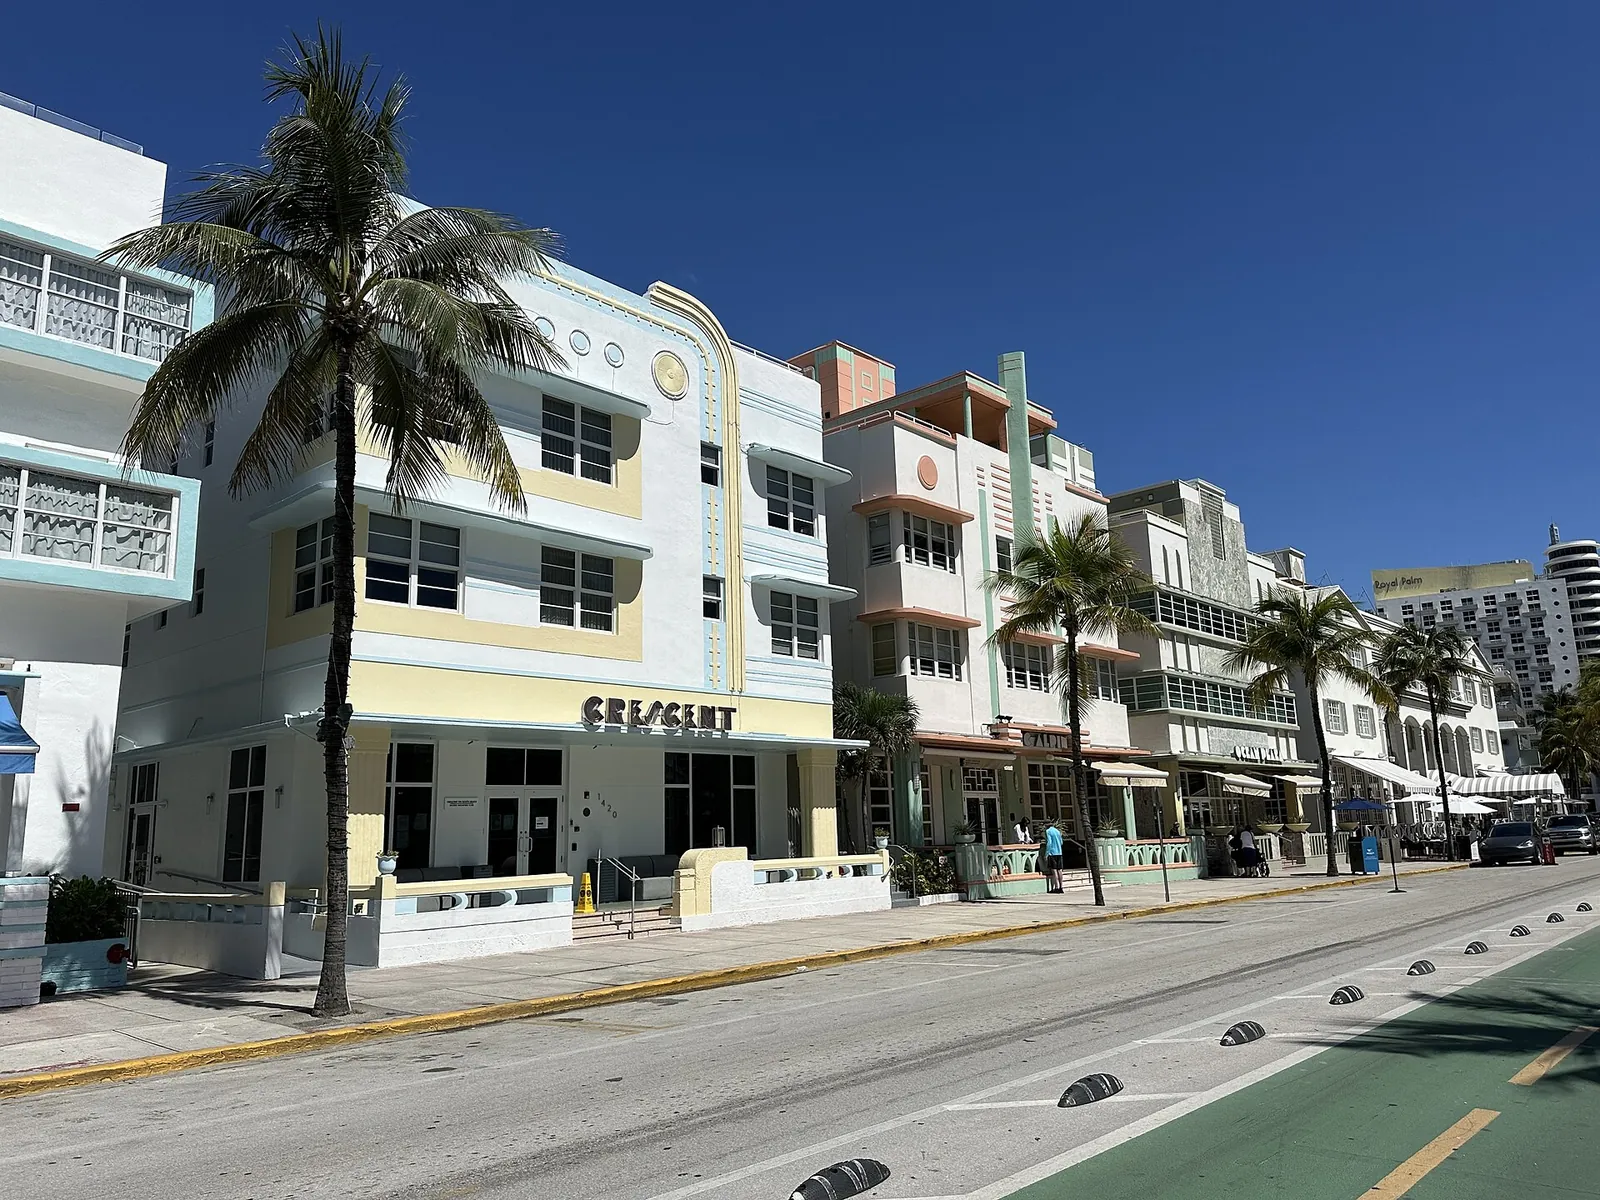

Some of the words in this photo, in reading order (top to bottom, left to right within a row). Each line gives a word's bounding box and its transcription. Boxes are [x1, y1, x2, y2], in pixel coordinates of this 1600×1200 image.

[1374, 576, 1398, 593] Royal
[1401, 575, 1423, 586] Palm
[582, 695, 737, 731] CRESCENT
[597, 792, 618, 819] 1420
